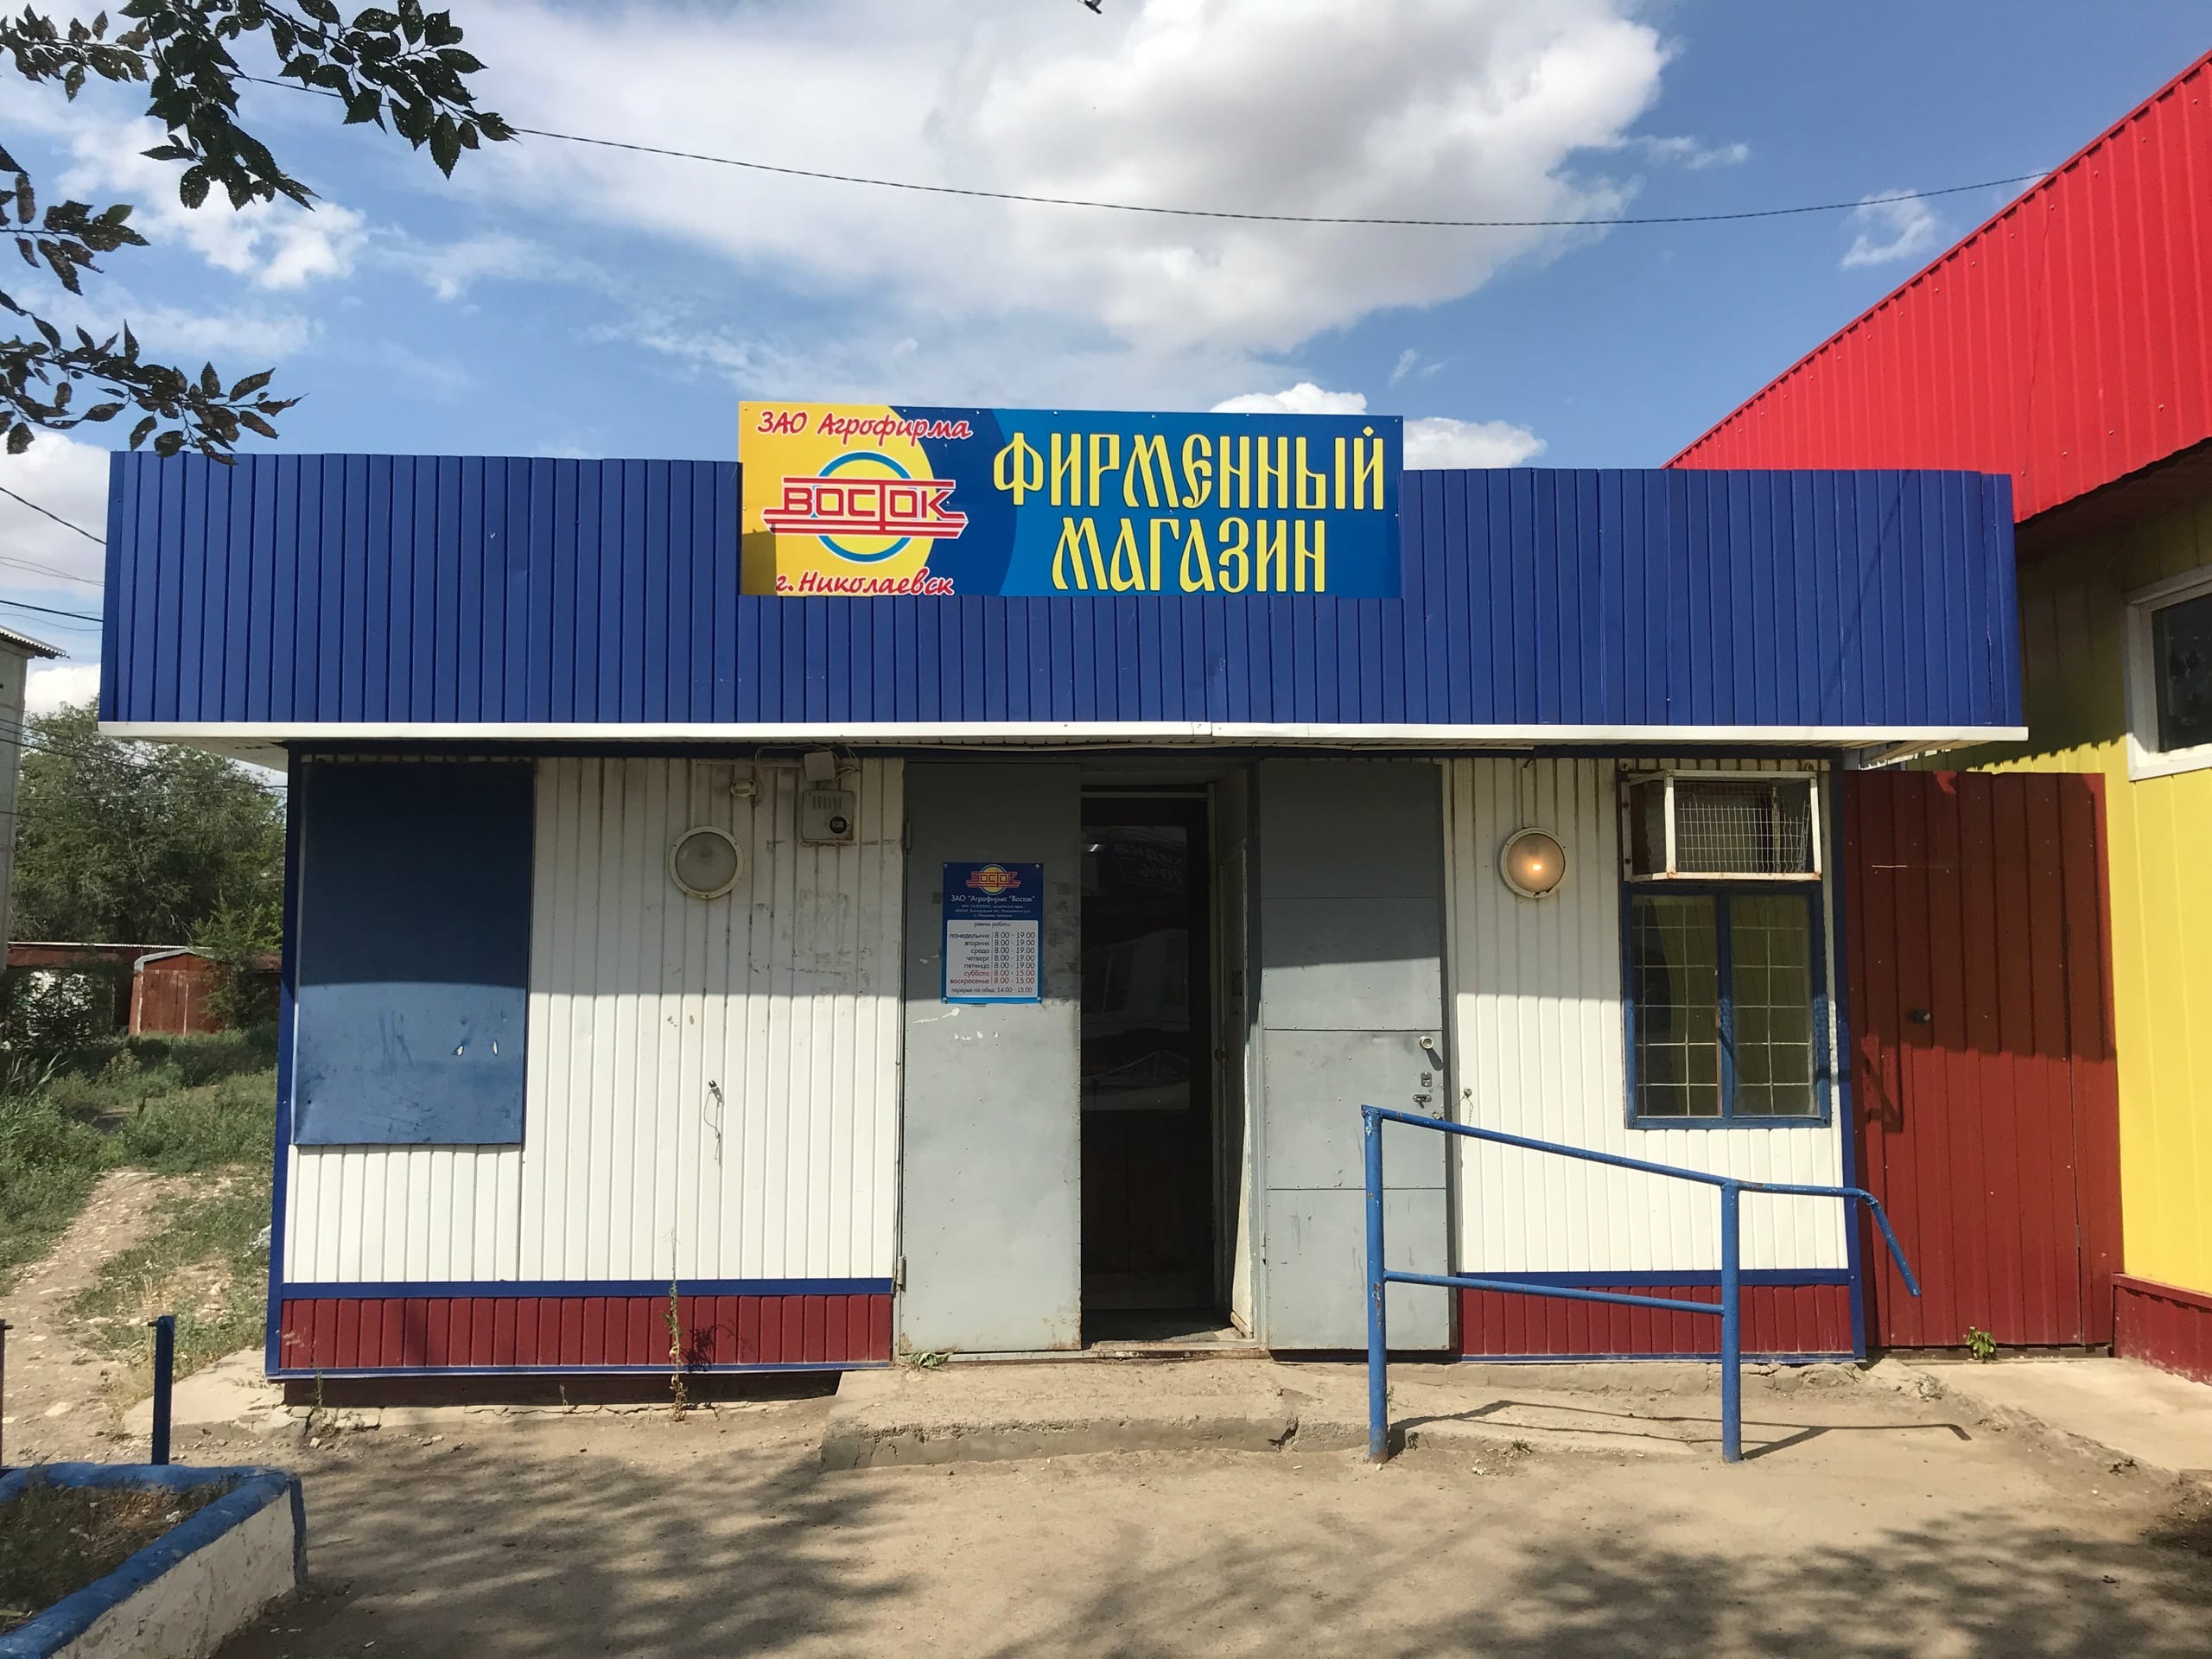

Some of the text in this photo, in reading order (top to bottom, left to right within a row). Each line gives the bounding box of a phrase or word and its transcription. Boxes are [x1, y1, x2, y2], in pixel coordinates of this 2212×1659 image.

[757, 411, 973, 447] ЗАО Агрофирма
[994, 426, 1384, 510] ФИРМЕННЫЙ
[763, 477, 967, 536] ВОСТОК
[1052, 517, 1325, 593] МАГАЗИН
